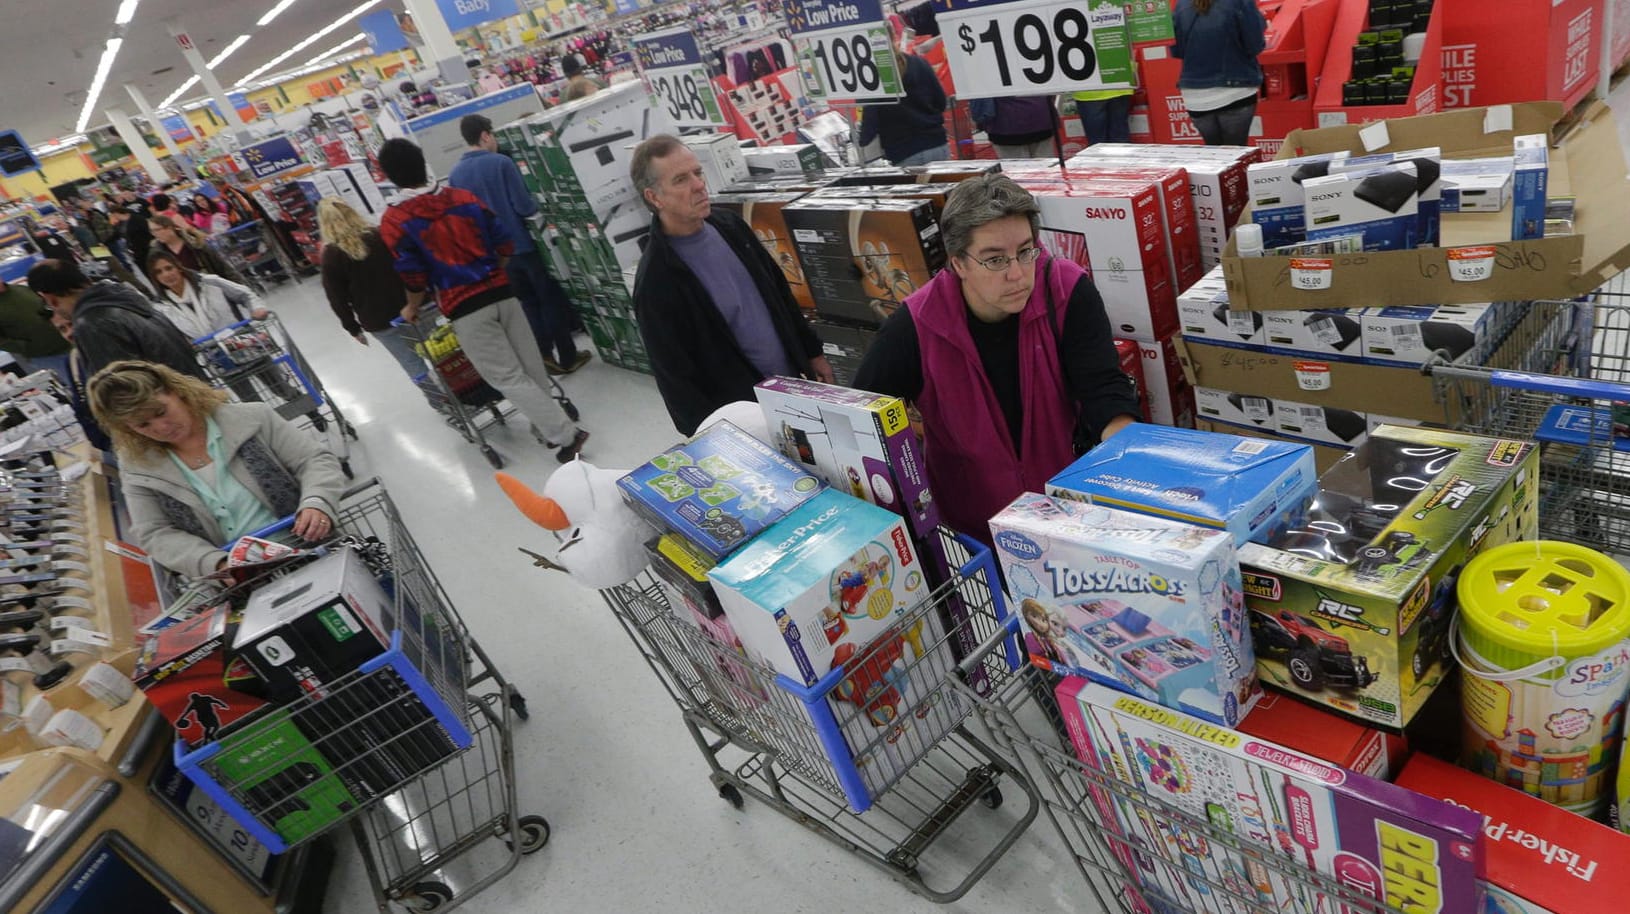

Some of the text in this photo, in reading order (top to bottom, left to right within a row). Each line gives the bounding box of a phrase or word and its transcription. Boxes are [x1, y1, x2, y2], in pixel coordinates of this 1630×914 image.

[454, 0, 490, 14] Baby
[805, 1, 859, 26] Low Price
[1091, 13, 1122, 23] Layaway
[650, 45, 686, 65] Low Price
[958, 8, 1096, 87] $198
[814, 34, 880, 93] 198
[1564, 50, 1588, 85] LAST
[652, 74, 707, 120] $348
[1444, 84, 1475, 106] ST
[1168, 112, 1190, 121] SUPP
[1170, 122, 1200, 137] LAS
[1254, 176, 1282, 185] SONY
[1189, 184, 1212, 197] ZIO
[1311, 191, 1343, 202] SONY
[1085, 207, 1126, 220] SANYO
[1199, 206, 1215, 221] 32
[1267, 316, 1294, 325] SONY
[1367, 325, 1387, 333] SO
[1278, 406, 1297, 414] SON
[886, 408, 898, 431] 150
[1001, 538, 1038, 555] FROZEN
[1318, 599, 1364, 621] RC
[1112, 697, 1242, 748] PERSONALIZED
[1255, 745, 1297, 769] JEWELRY
[72, 852, 109, 891] SAMSUNG
